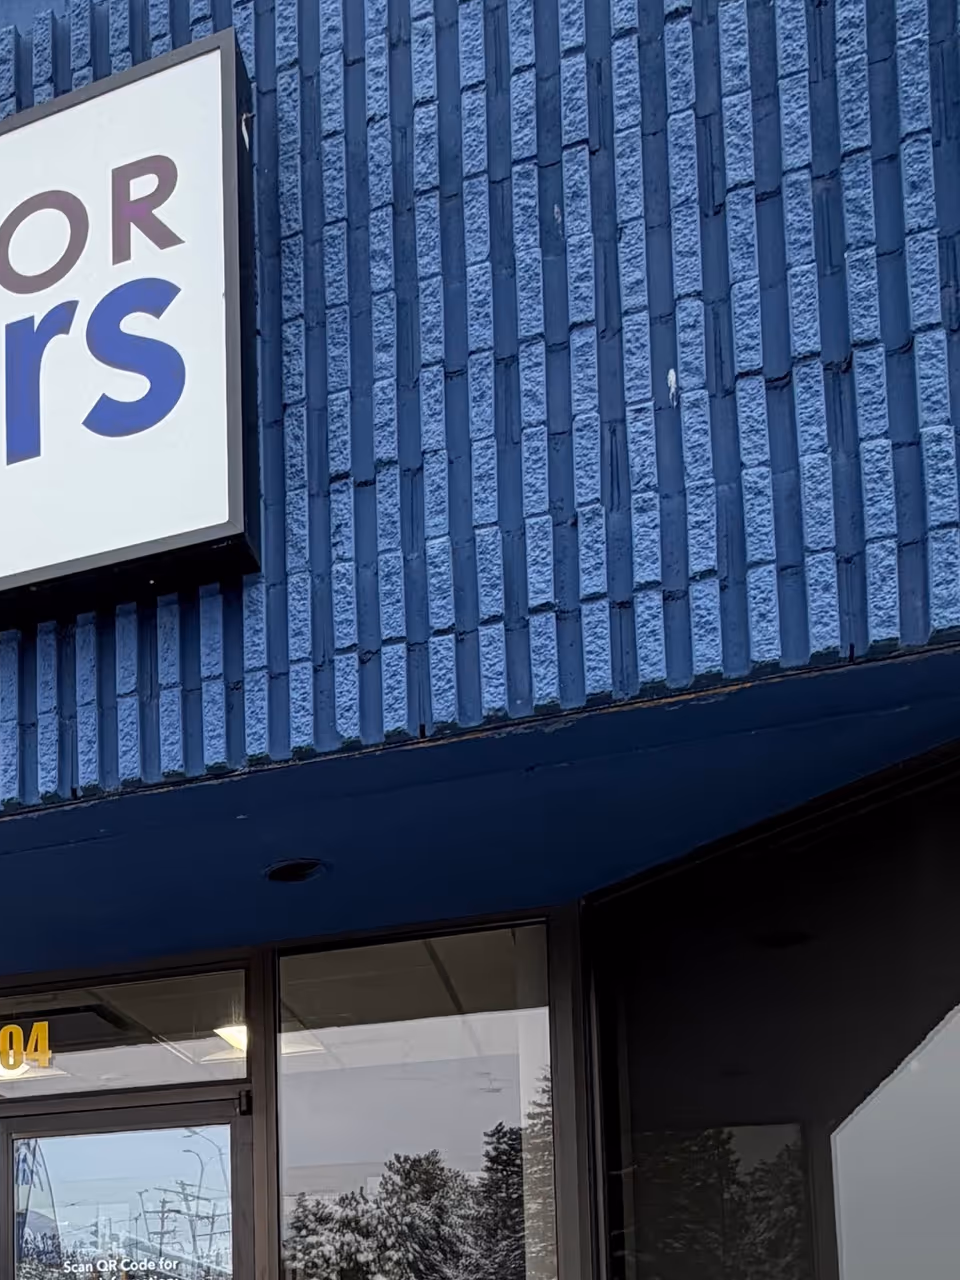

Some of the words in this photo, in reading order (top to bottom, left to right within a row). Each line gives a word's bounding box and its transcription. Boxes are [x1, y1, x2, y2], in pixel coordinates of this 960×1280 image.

[63, 1260, 93, 1273] Scan
[96, 1259, 117, 1272] QR
[120, 1258, 156, 1271] Code
[159, 1257, 179, 1270] for
